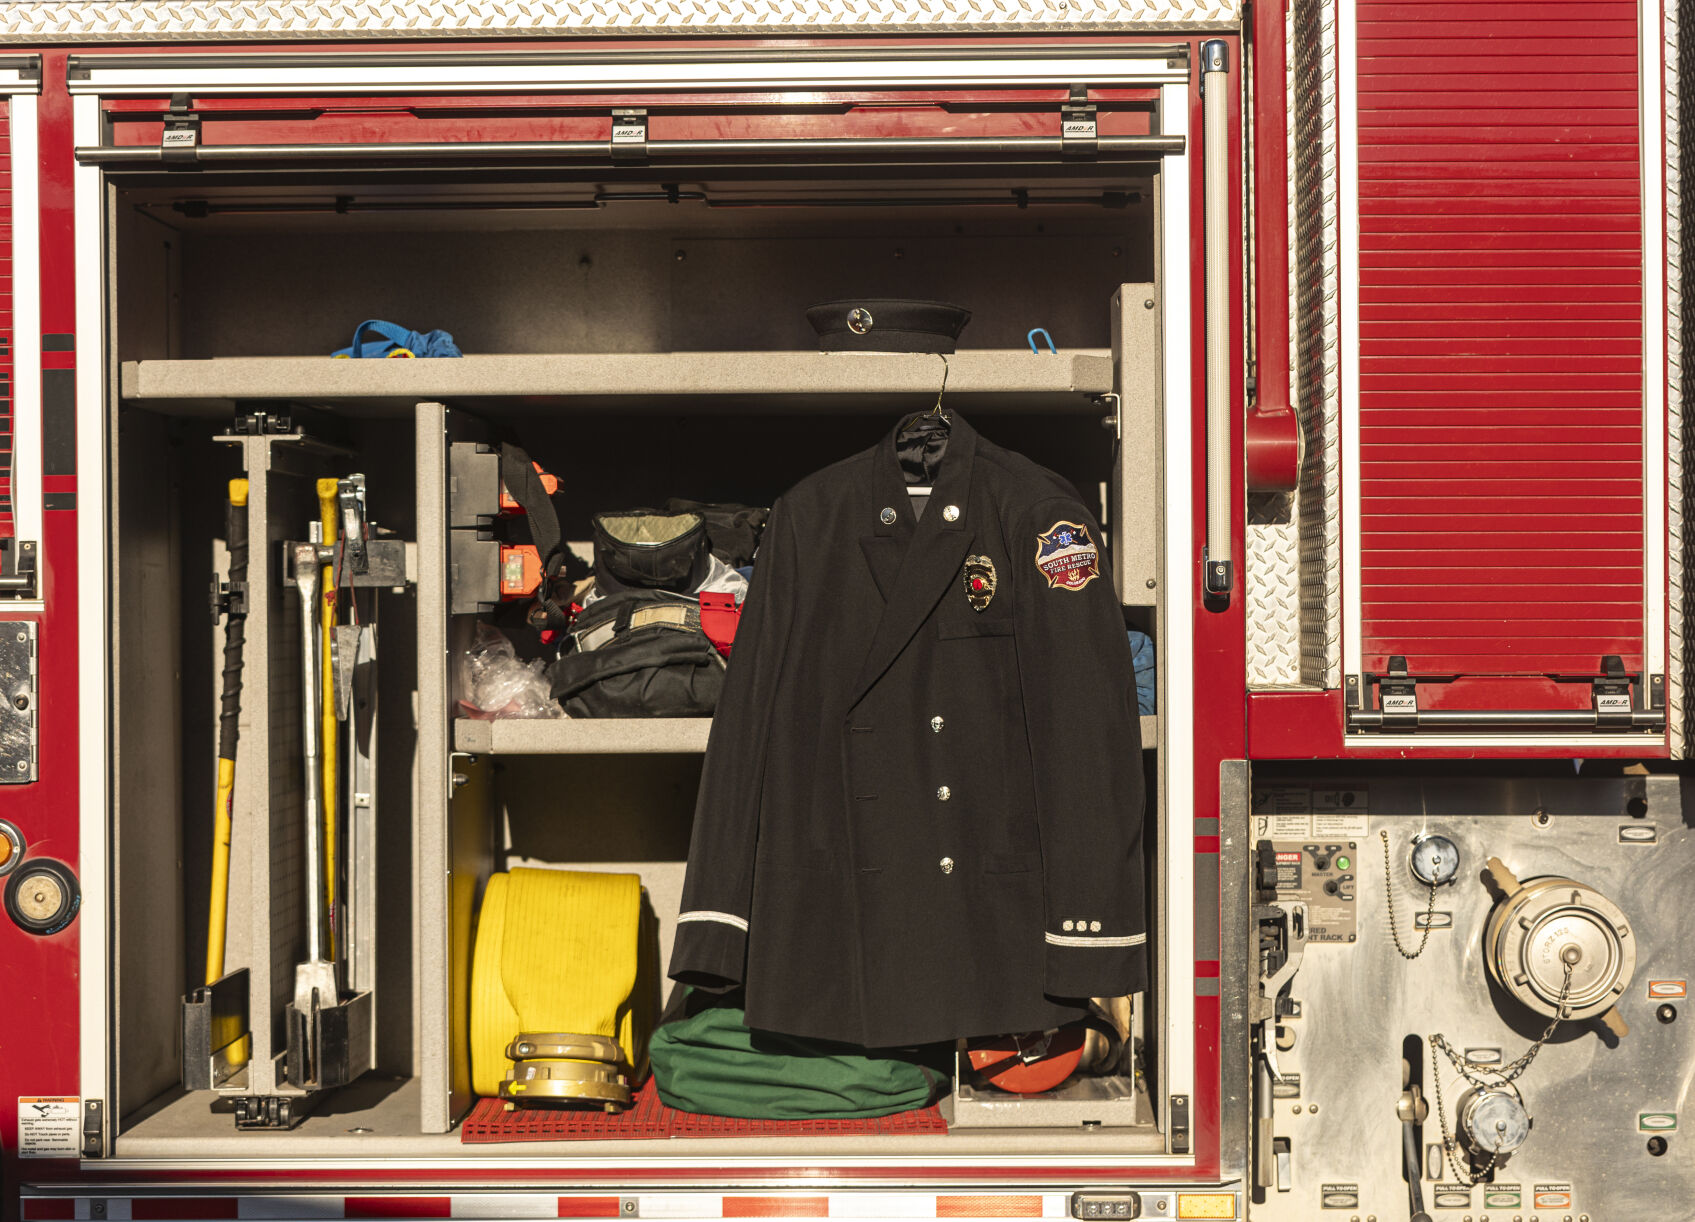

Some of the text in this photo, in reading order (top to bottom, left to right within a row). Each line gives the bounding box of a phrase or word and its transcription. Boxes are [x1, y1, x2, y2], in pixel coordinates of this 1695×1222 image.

[1043, 553, 1096, 571] SOUTH METRO
[1050, 559, 1092, 574] FIRE RESCUE
